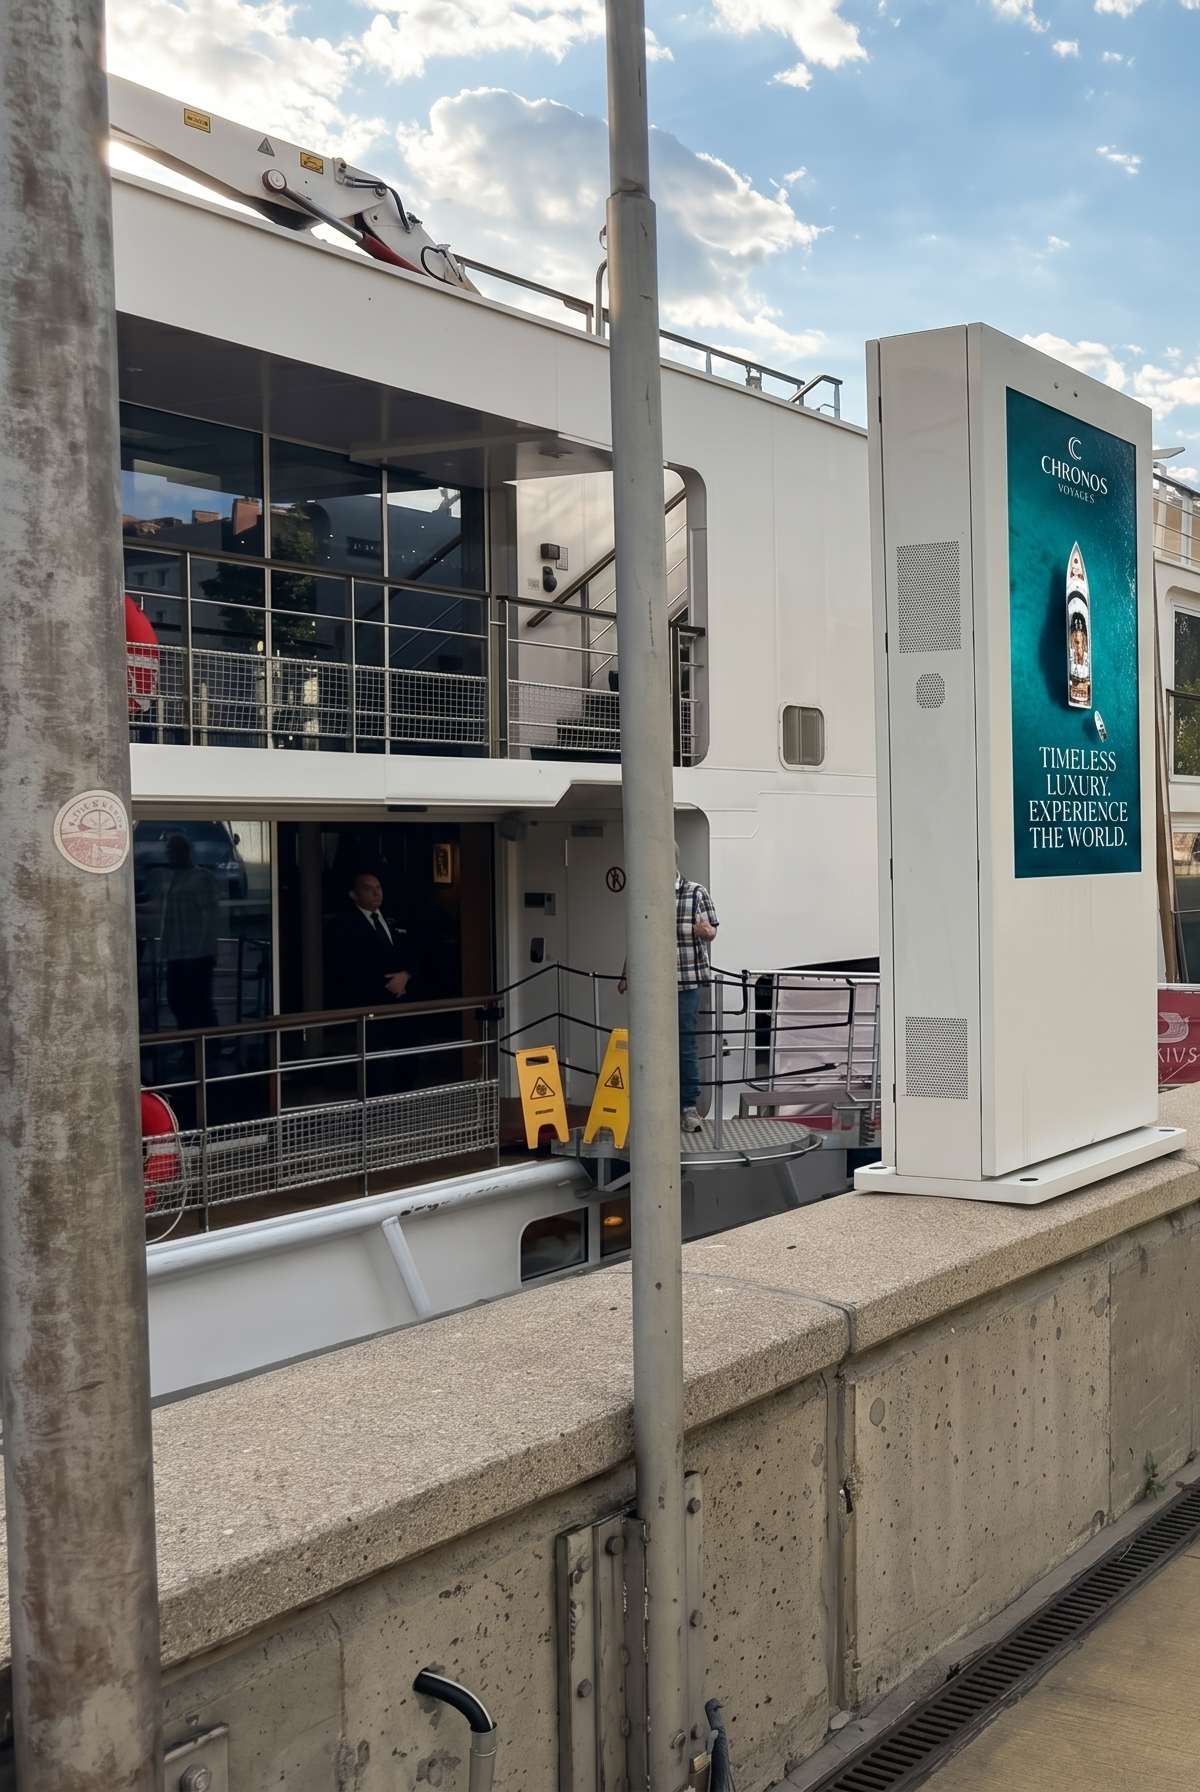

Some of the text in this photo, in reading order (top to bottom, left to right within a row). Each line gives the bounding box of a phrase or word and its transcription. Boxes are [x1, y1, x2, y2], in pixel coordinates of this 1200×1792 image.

[1041, 455, 1108, 495] CHRONOS
[1058, 483, 1095, 504] VOYAGES
[1039, 746, 1117, 772] TIMELESS
[1047, 773, 1111, 797] LUXURY.
[1029, 800, 1129, 822] EXPERIENCE
[1029, 826, 1128, 849] THE WORLD.
